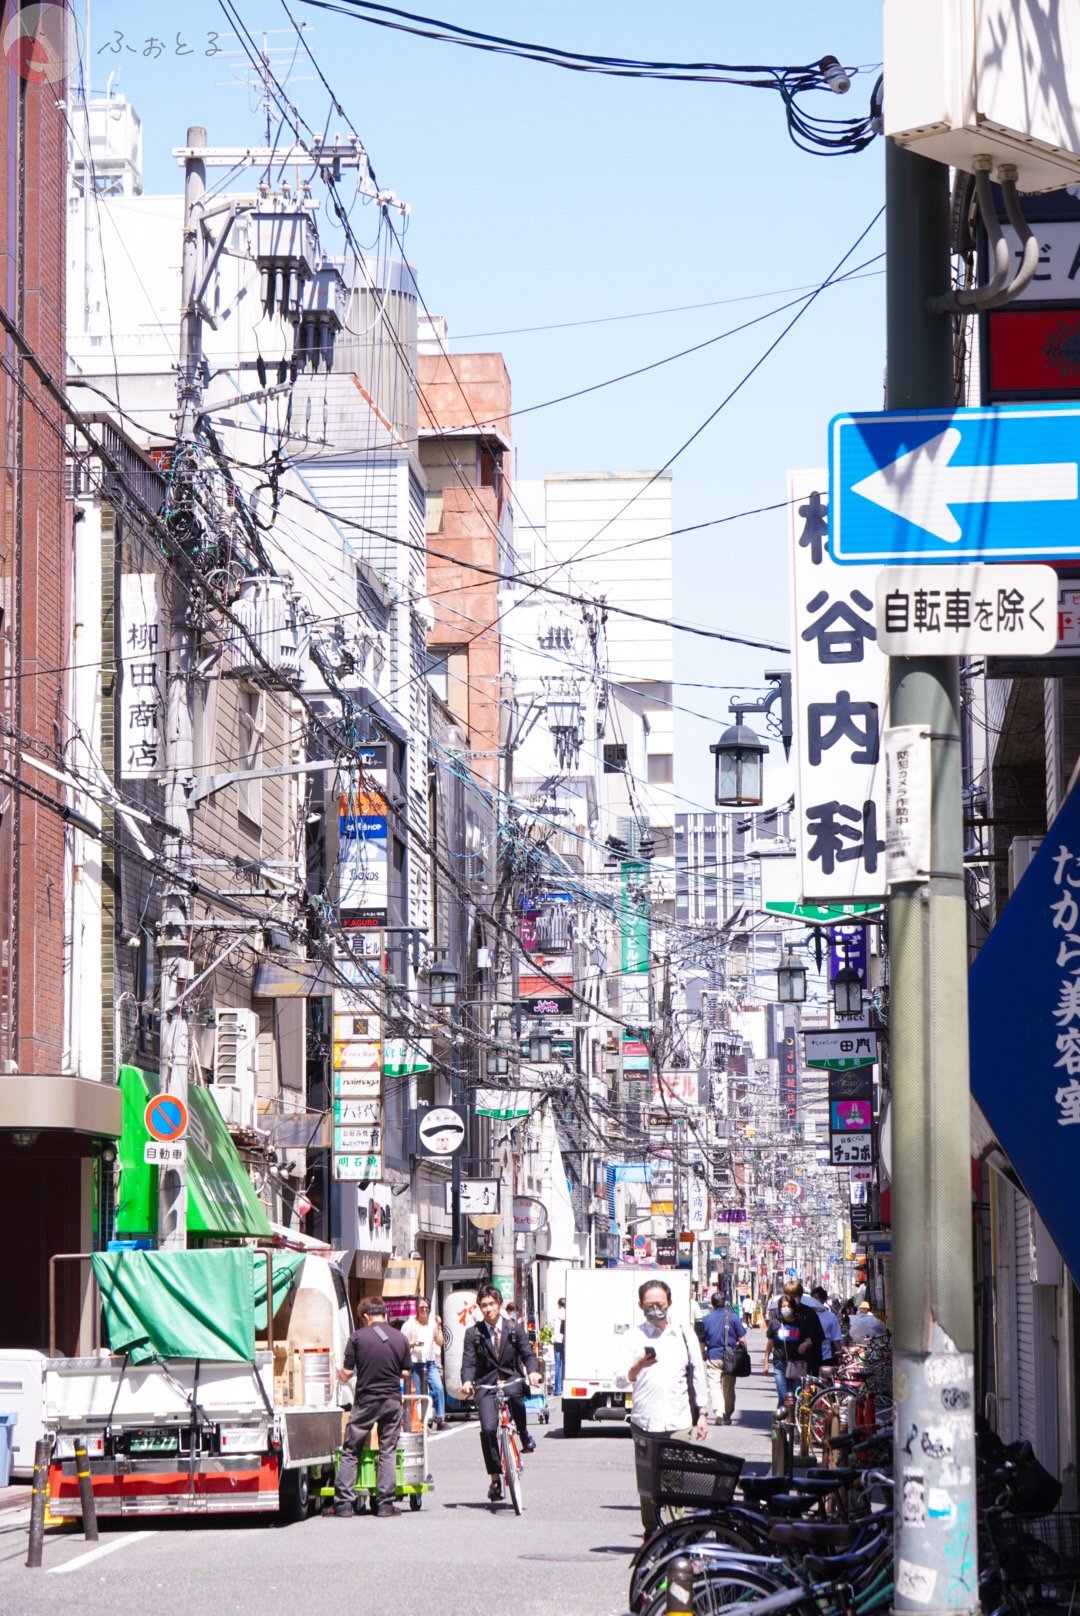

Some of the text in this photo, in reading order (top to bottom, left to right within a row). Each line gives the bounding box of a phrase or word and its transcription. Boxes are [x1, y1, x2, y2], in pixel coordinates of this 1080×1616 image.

[885, 588, 1045, 633] 自転車を除く
[127, 623, 159, 768] 柳田商店
[343, 919, 379, 927] MAGURO
[146, 1147, 182, 1160] 自動車
